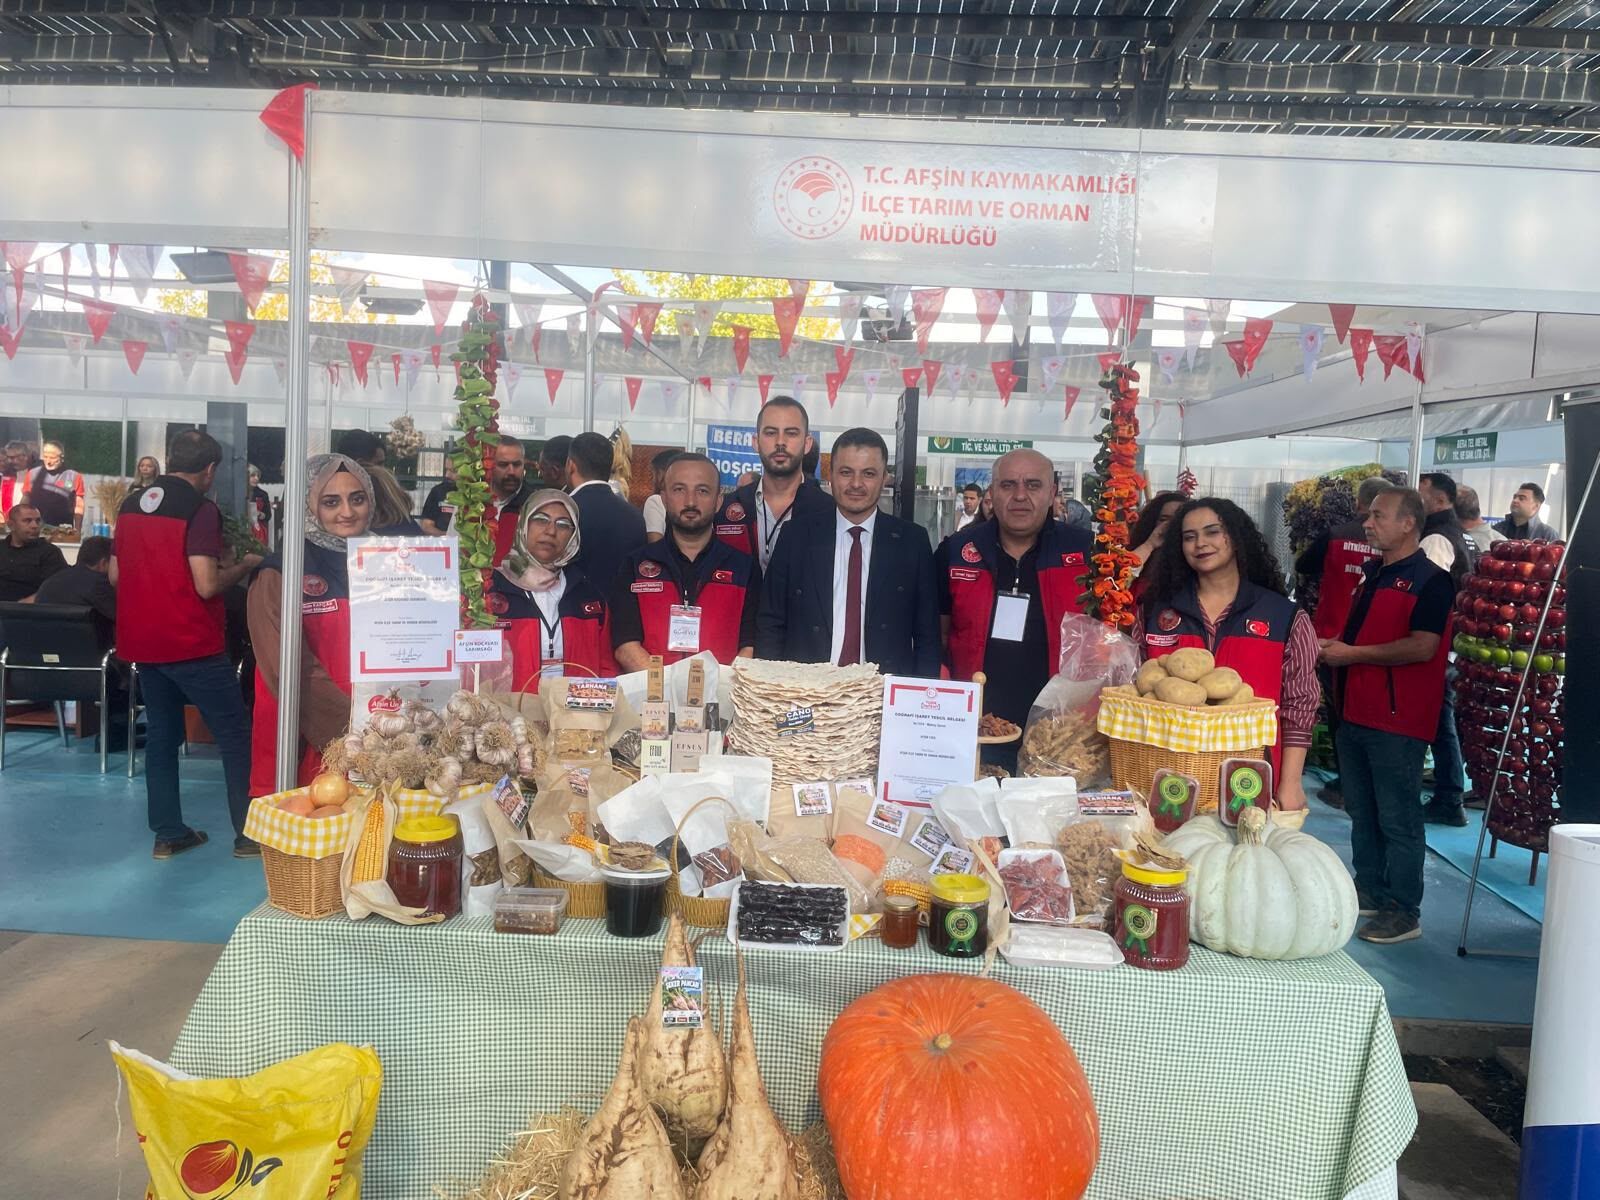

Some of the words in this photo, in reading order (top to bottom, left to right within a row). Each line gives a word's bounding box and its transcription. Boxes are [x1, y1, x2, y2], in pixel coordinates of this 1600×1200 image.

[863, 165, 898, 185] T.C.
[903, 166, 965, 191] AFŞİN
[971, 170, 1137, 195] KAYMAKAMLIĞI
[861, 191, 905, 219] İLÇE
[908, 197, 973, 217] TARIM
[978, 200, 1004, 218] VE
[1009, 201, 1090, 222] ORMAN
[860, 222, 997, 247] MÜDÜRLÜĞÜ
[713, 429, 753, 447] BERA
[974, 443, 983, 452] VE
